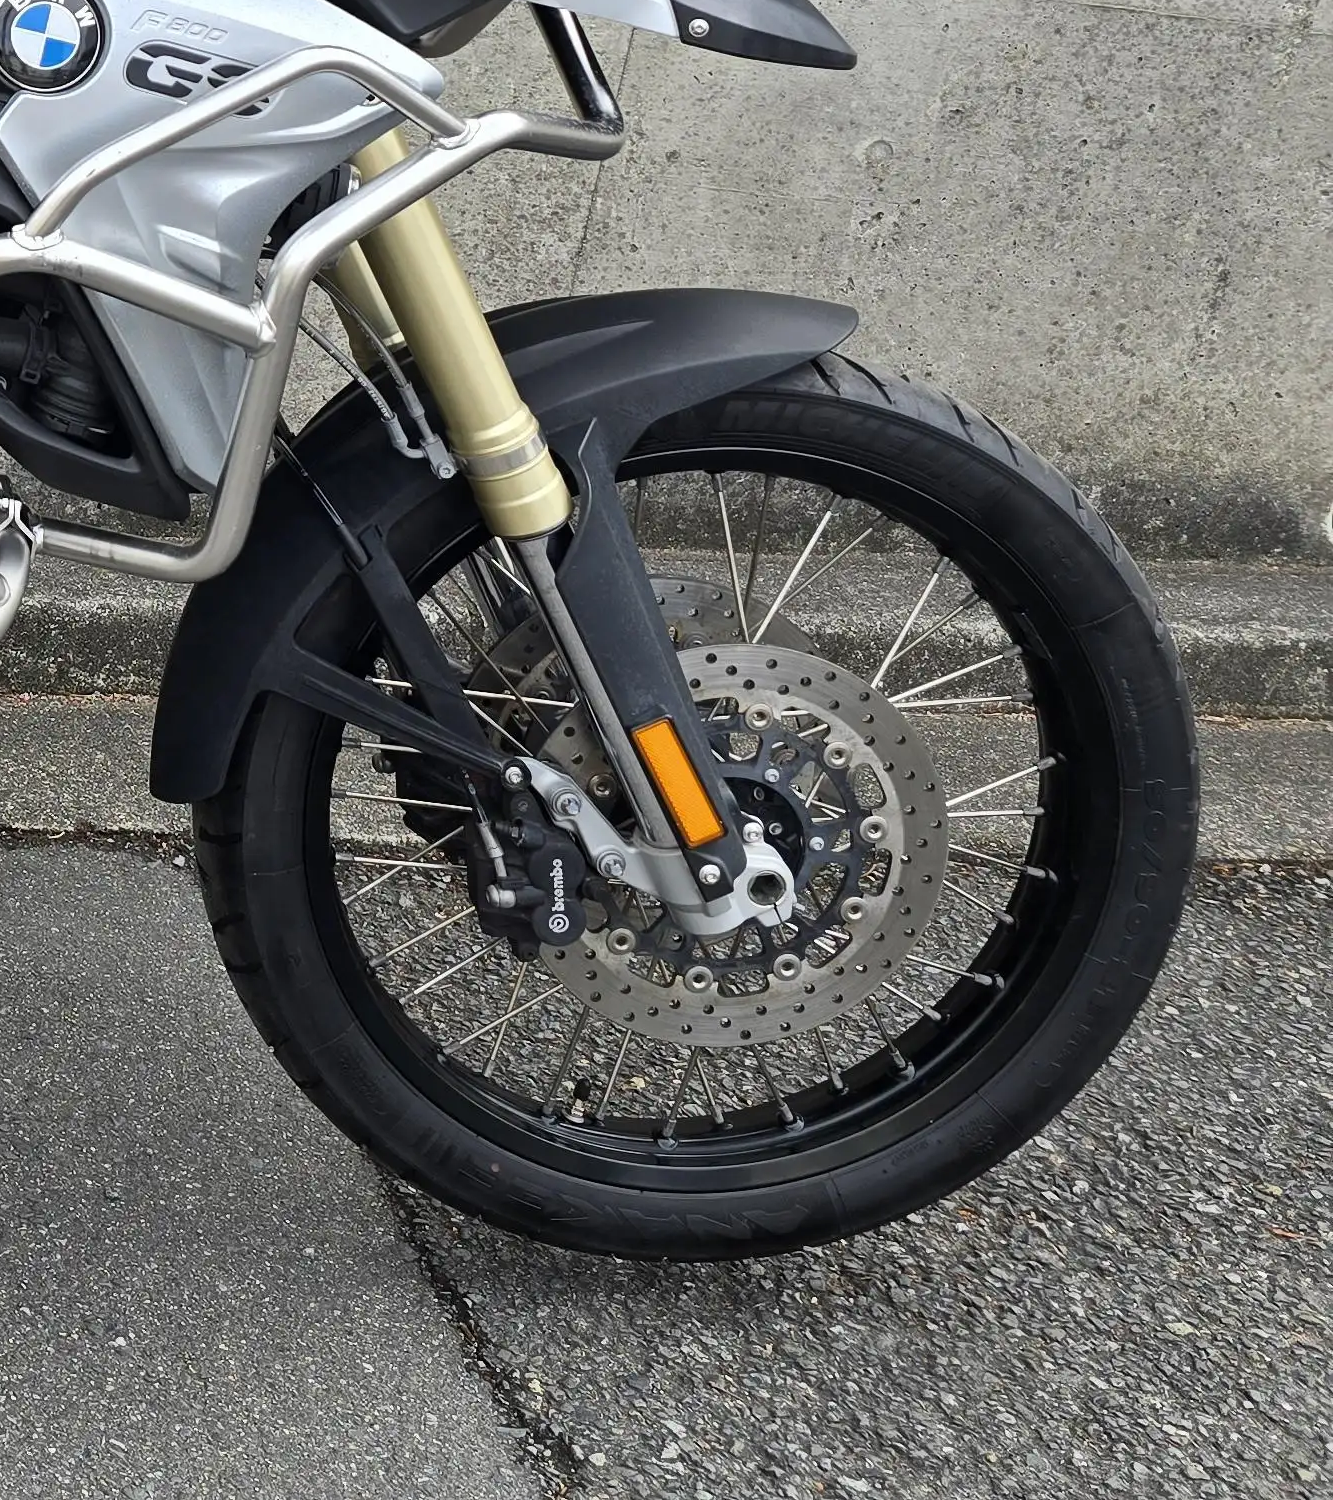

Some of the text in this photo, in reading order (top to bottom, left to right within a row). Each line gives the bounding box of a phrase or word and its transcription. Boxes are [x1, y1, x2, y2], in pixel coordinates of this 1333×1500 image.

[129, 8, 230, 45] F 800
[549, 858, 565, 912] brembo
